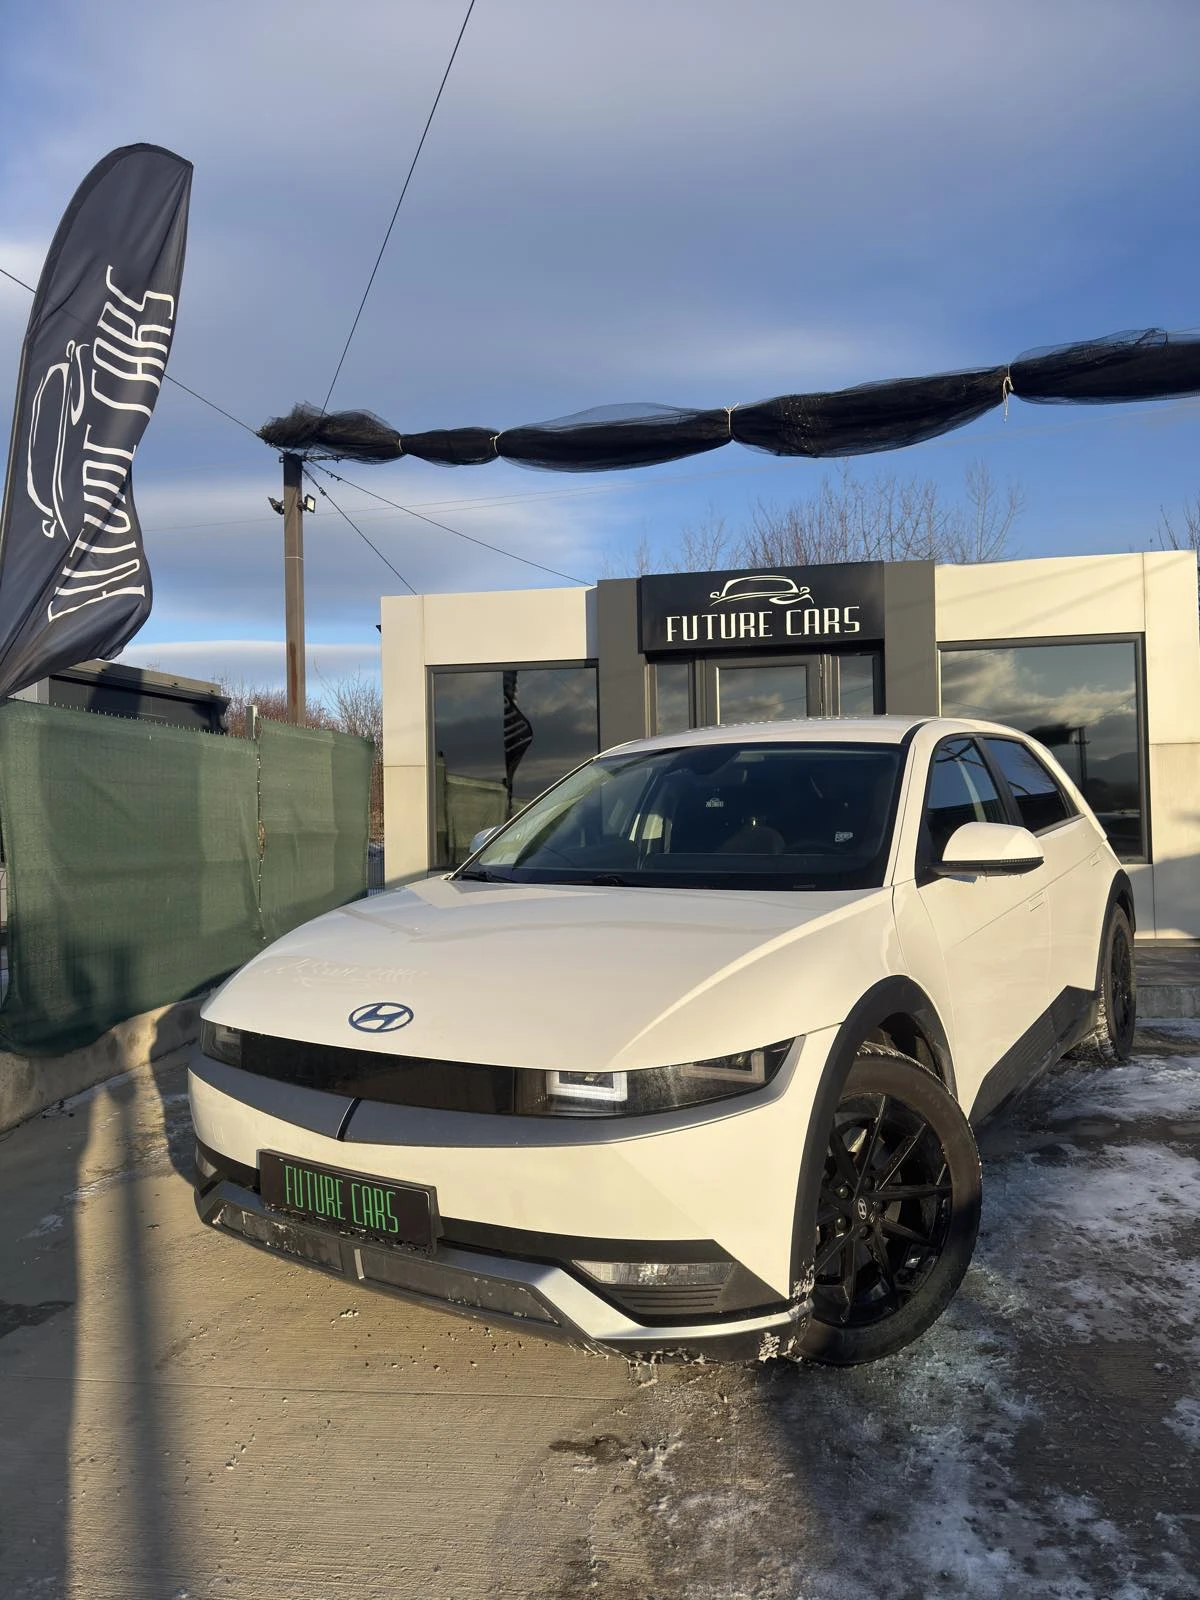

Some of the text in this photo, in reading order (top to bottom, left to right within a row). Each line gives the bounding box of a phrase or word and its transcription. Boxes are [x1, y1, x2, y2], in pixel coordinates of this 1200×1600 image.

[91, 264, 175, 418] CARS
[665, 605, 860, 642] FUTURE CARS
[284, 1165, 399, 1233] FUTURE CARS
